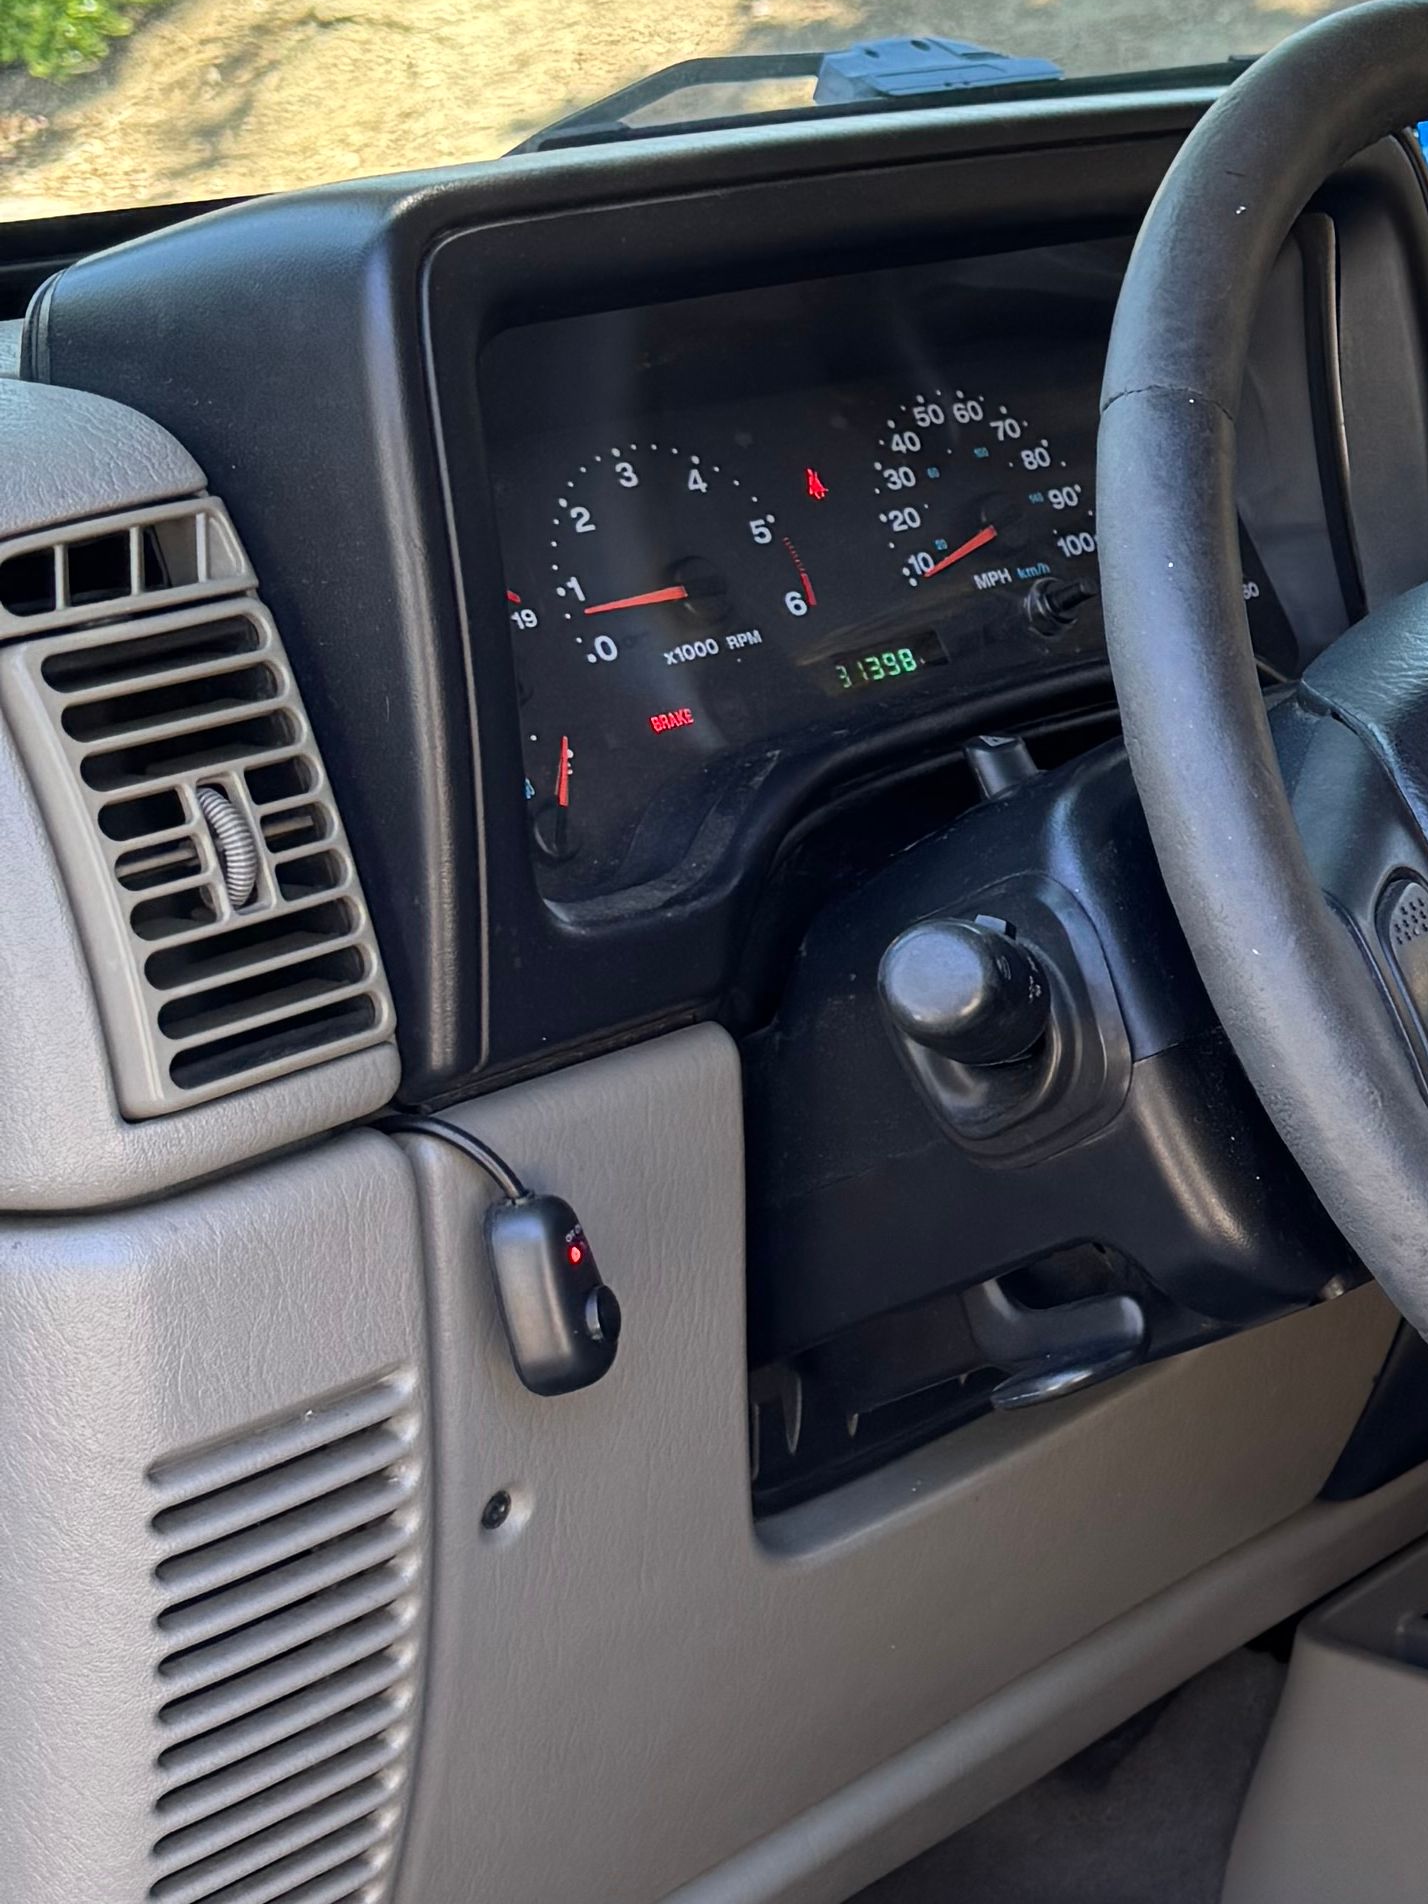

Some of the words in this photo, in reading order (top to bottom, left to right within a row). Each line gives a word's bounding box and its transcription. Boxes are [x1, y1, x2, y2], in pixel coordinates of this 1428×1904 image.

[913, 403, 945, 427] 50
[952, 400, 984, 424] 60
[989, 418, 1021, 441] 70
[890, 431, 921, 455] 40
[1020, 447, 1051, 471] 80
[615, 462, 639, 487] 3
[688, 468, 708, 493] 4
[883, 466, 917, 490] 30
[1047, 486, 1079, 510] 90
[570, 506, 597, 533] 2
[749, 518, 773, 544] 5
[888, 507, 922, 532] 20
[1056, 532, 1096, 558] 100
[907, 551, 935, 575] 10
[973, 567, 1013, 590] MPH
[1016, 562, 1051, 580] km/h
[566, 576, 586, 602] 1
[784, 590, 808, 617] 6
[510, 608, 538, 630] 19
[594, 635, 618, 662] 0
[663, 637, 720, 665] x1000
[725, 629, 763, 651] RPM
[835, 647, 918, 689] 31398
[650, 707, 695, 735] BRAKE
